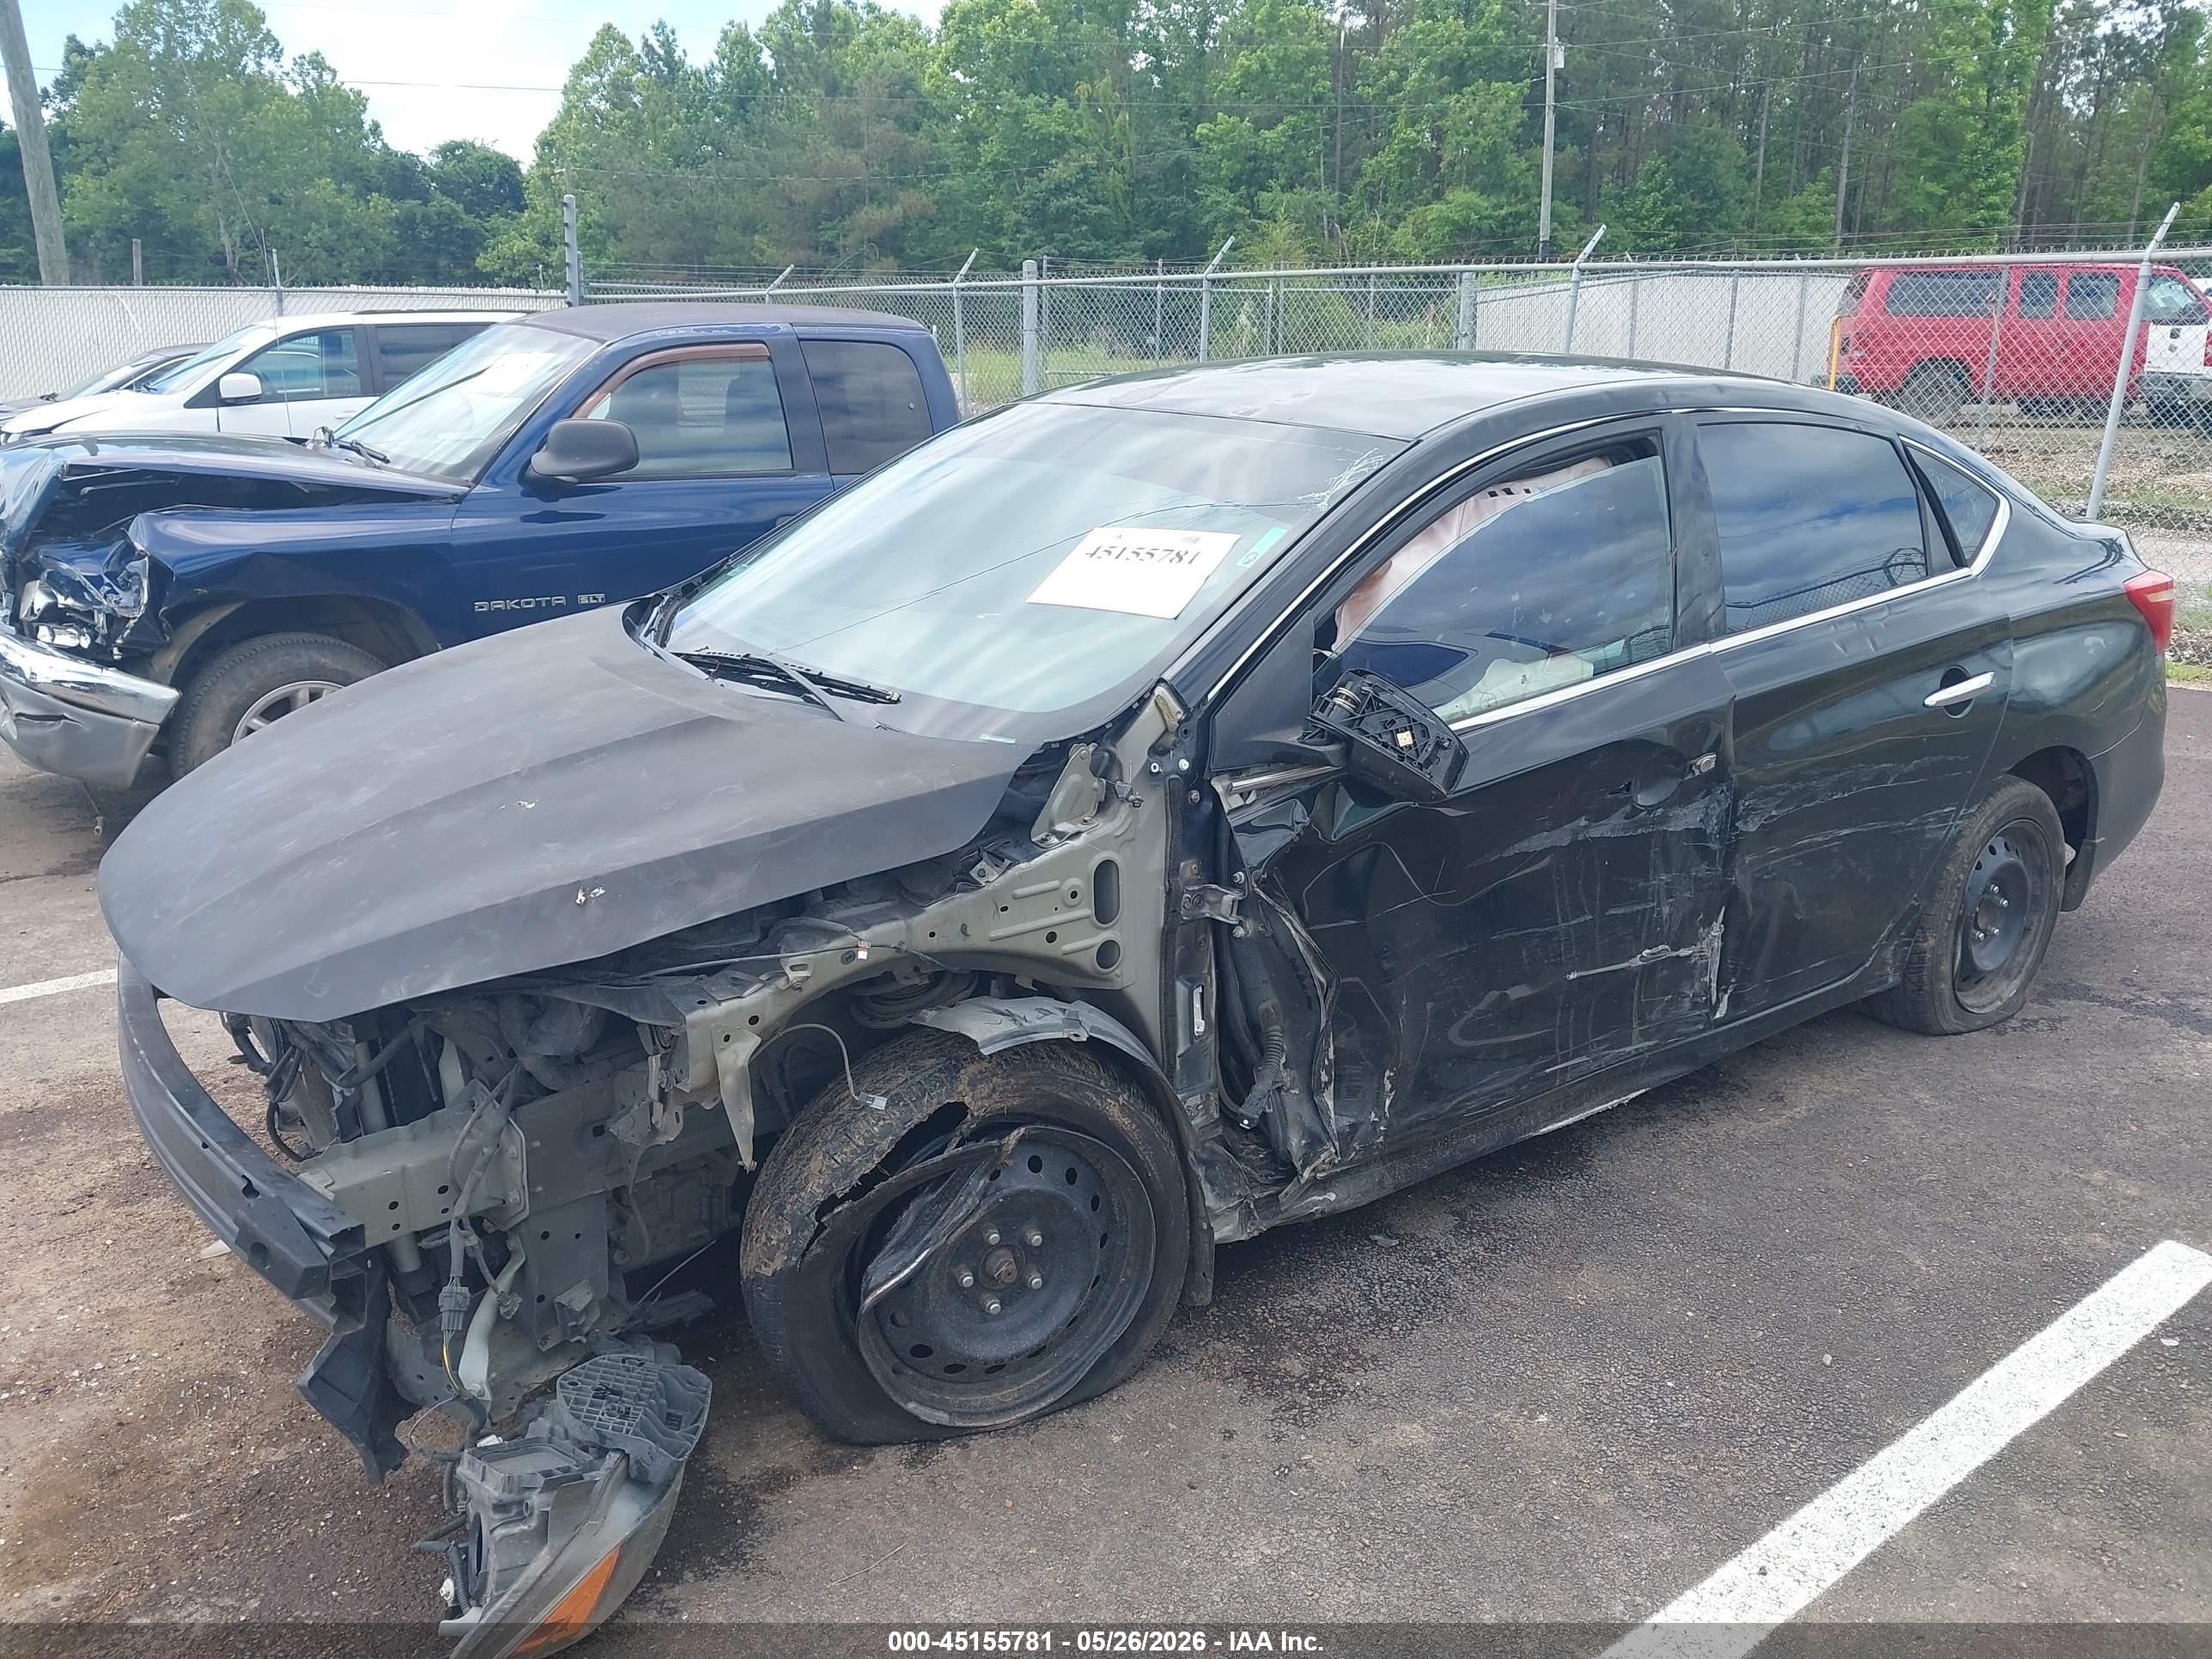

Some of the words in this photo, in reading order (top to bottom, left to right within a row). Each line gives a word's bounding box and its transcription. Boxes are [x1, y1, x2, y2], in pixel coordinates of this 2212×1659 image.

[1085, 544, 1202, 565] 45155781
[474, 596, 567, 612] DAKOTA
[577, 593, 605, 605] SLT
